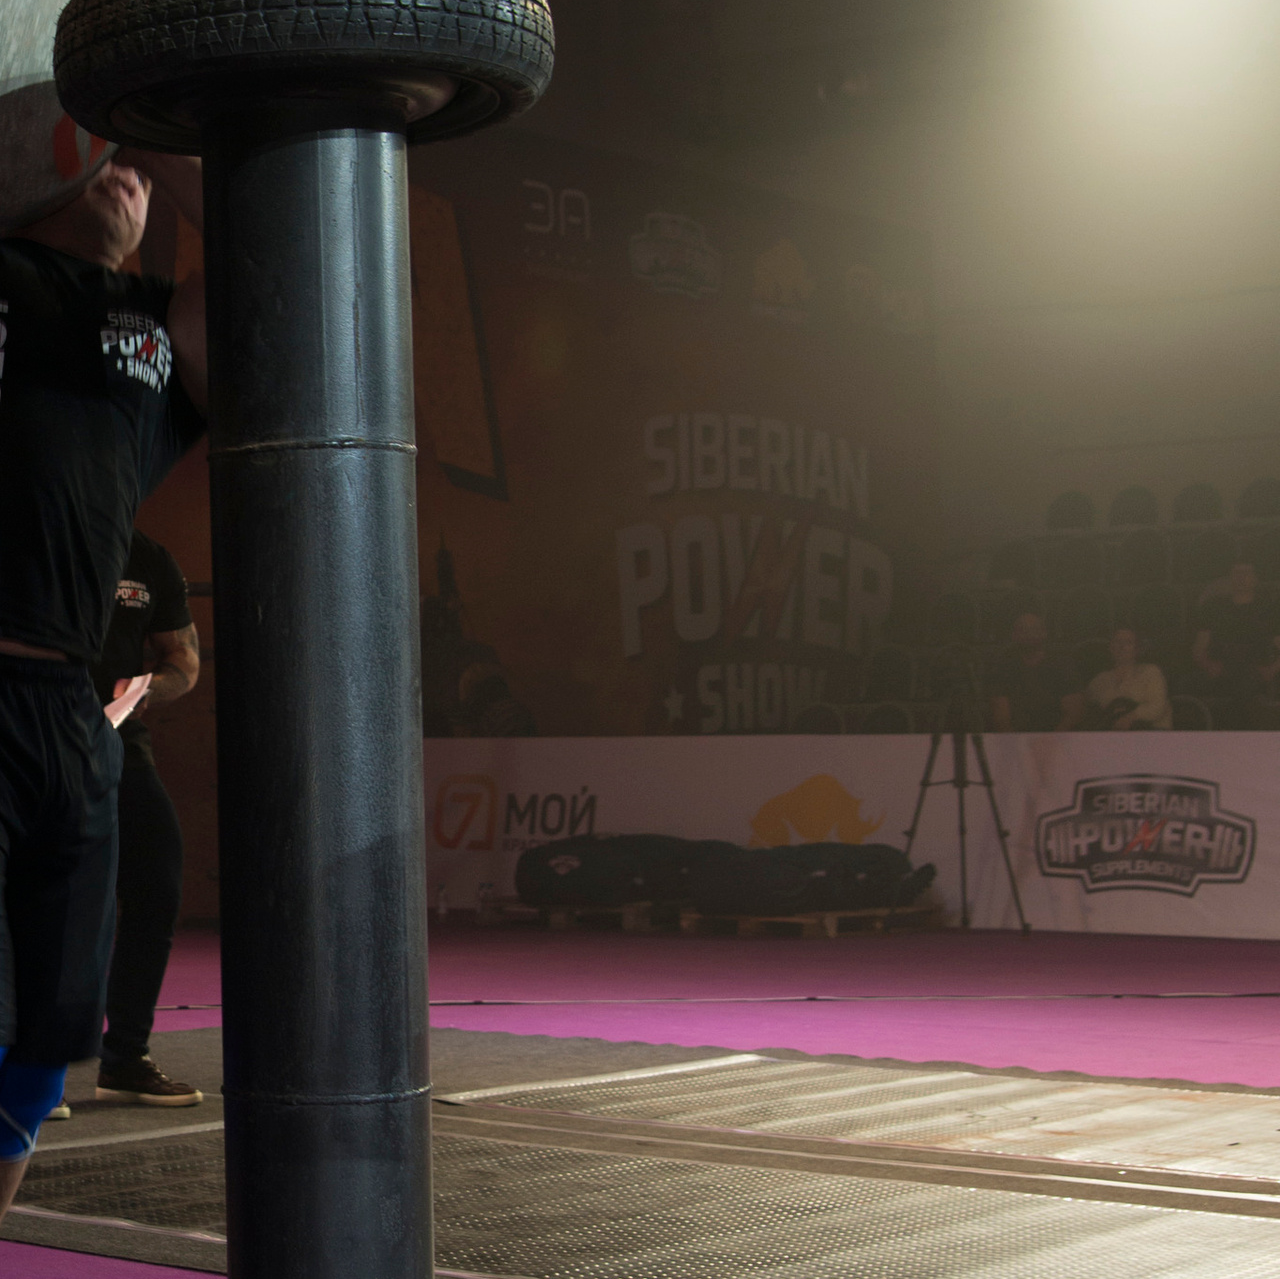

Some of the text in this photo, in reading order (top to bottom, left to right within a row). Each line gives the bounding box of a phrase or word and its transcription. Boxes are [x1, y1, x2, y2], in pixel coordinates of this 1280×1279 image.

[642, 412, 869, 519] SIBERIAN
[615, 513, 895, 659] POWER
[503, 785, 598, 838] МОЙ
[1091, 791, 1201, 820] SIBERIAN
[1077, 817, 1209, 861] POWER
